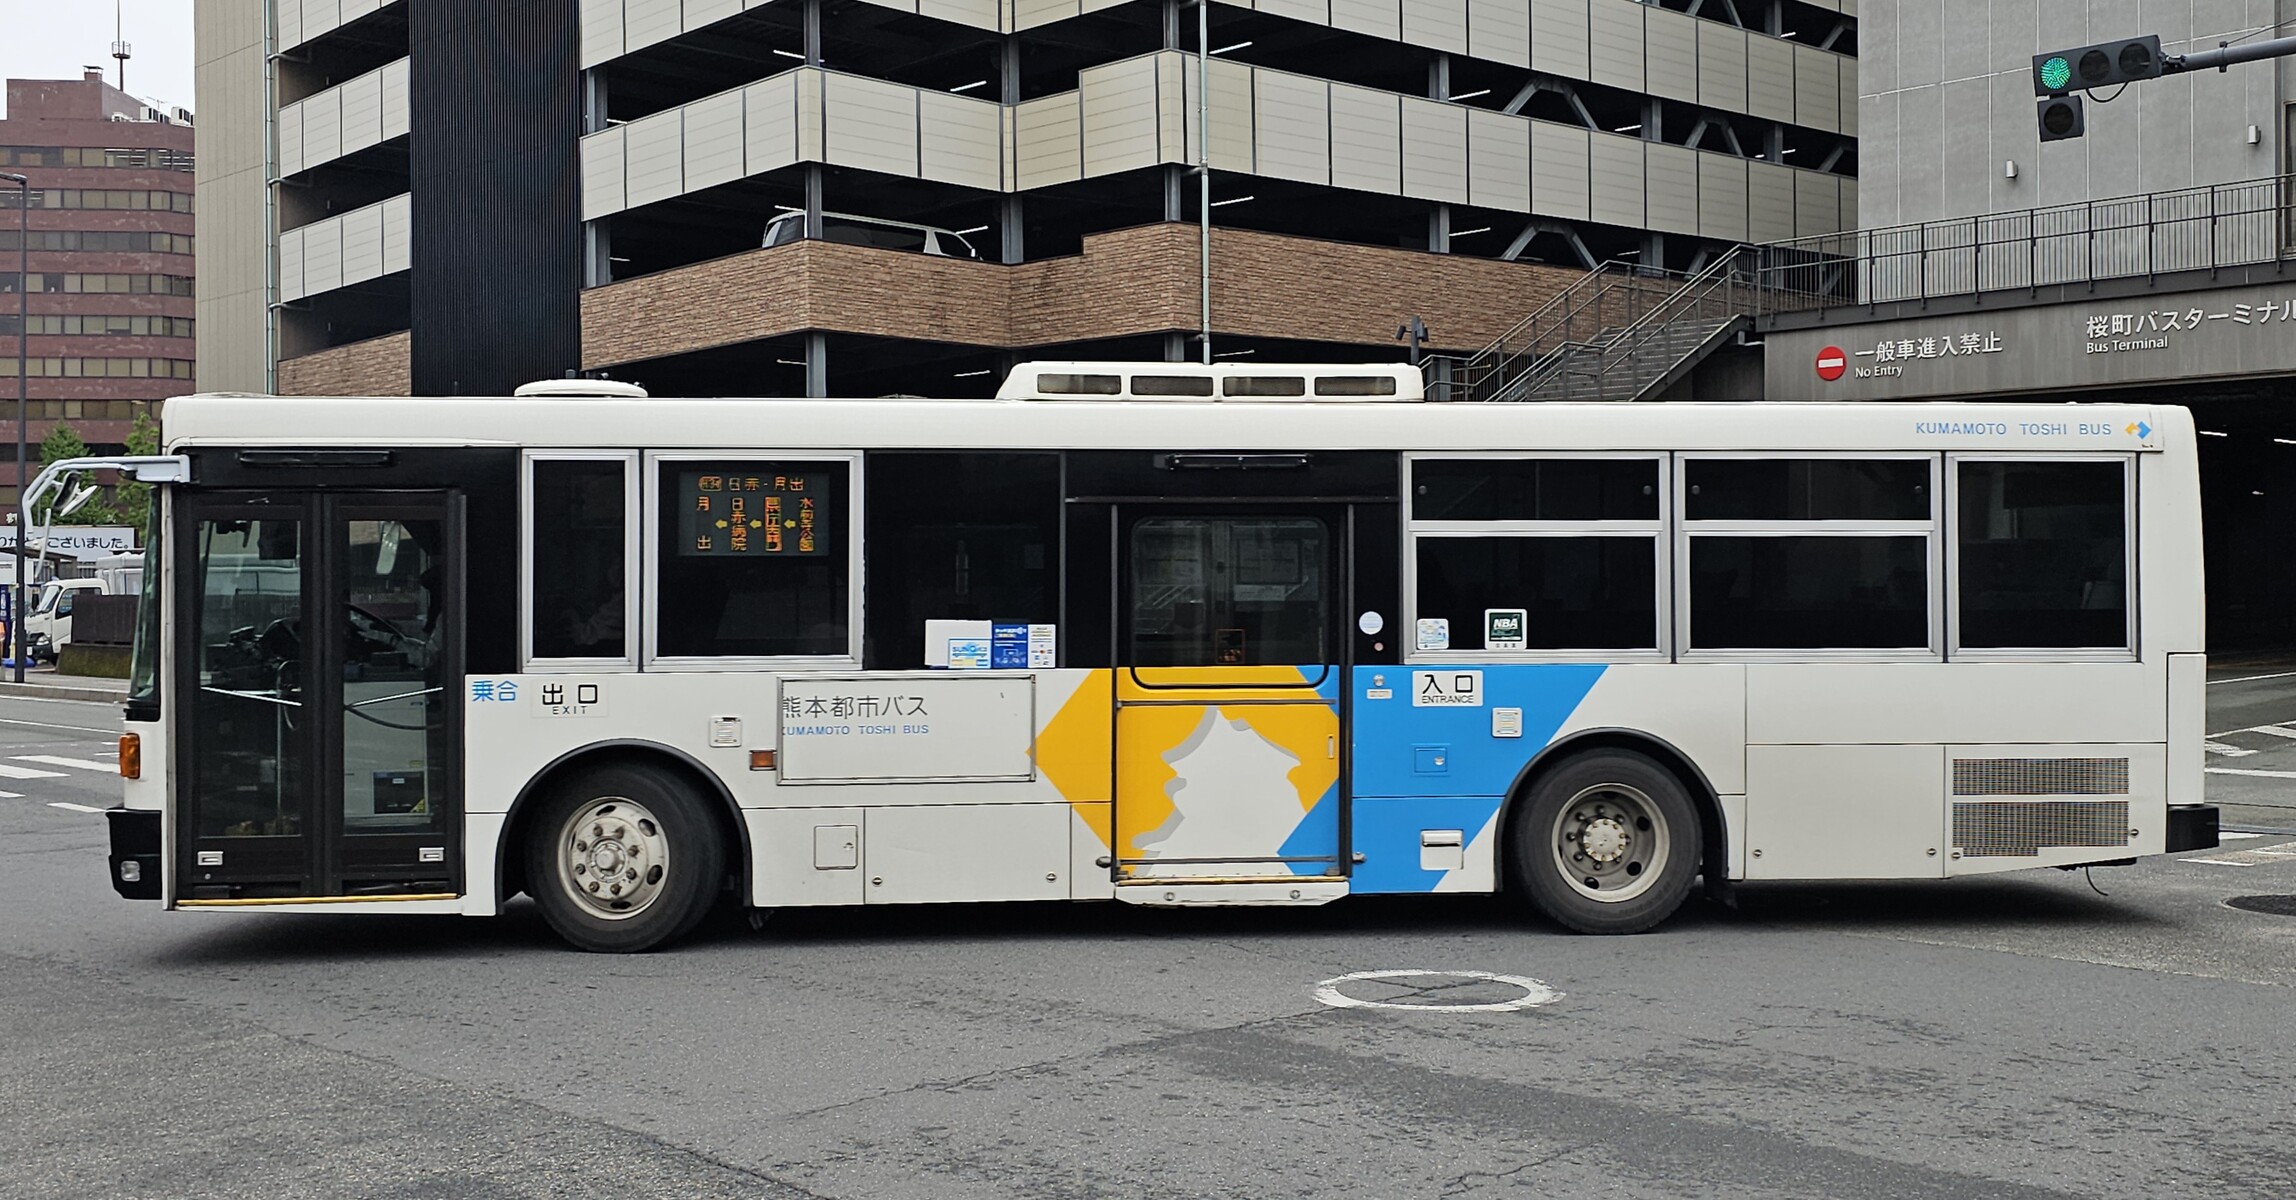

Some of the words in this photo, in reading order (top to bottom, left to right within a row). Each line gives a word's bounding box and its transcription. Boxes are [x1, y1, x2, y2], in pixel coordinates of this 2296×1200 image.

[1855, 331, 2003, 363] 一般車進入禁止
[2086, 342, 2109, 354] Bus
[2112, 336, 2168, 351] Terminal
[1855, 367, 1871, 378] No
[1874, 365, 1903, 378] Entry
[1916, 422, 2007, 435] KUMAMOTO
[2019, 423, 2068, 435] TOSHI
[2079, 423, 2112, 435] BUS
[1493, 618, 1519, 629] NBA
[472, 680, 518, 702] 乗合
[1422, 674, 1474, 694] 入口
[542, 683, 598, 705] 出口
[1421, 695, 1474, 703] ENTRANCE
[552, 705, 588, 714] EXIT
[783, 695, 928, 719] 熊本都市バス
[858, 725, 896, 735] TOSHI
[903, 725, 929, 734] BUS
